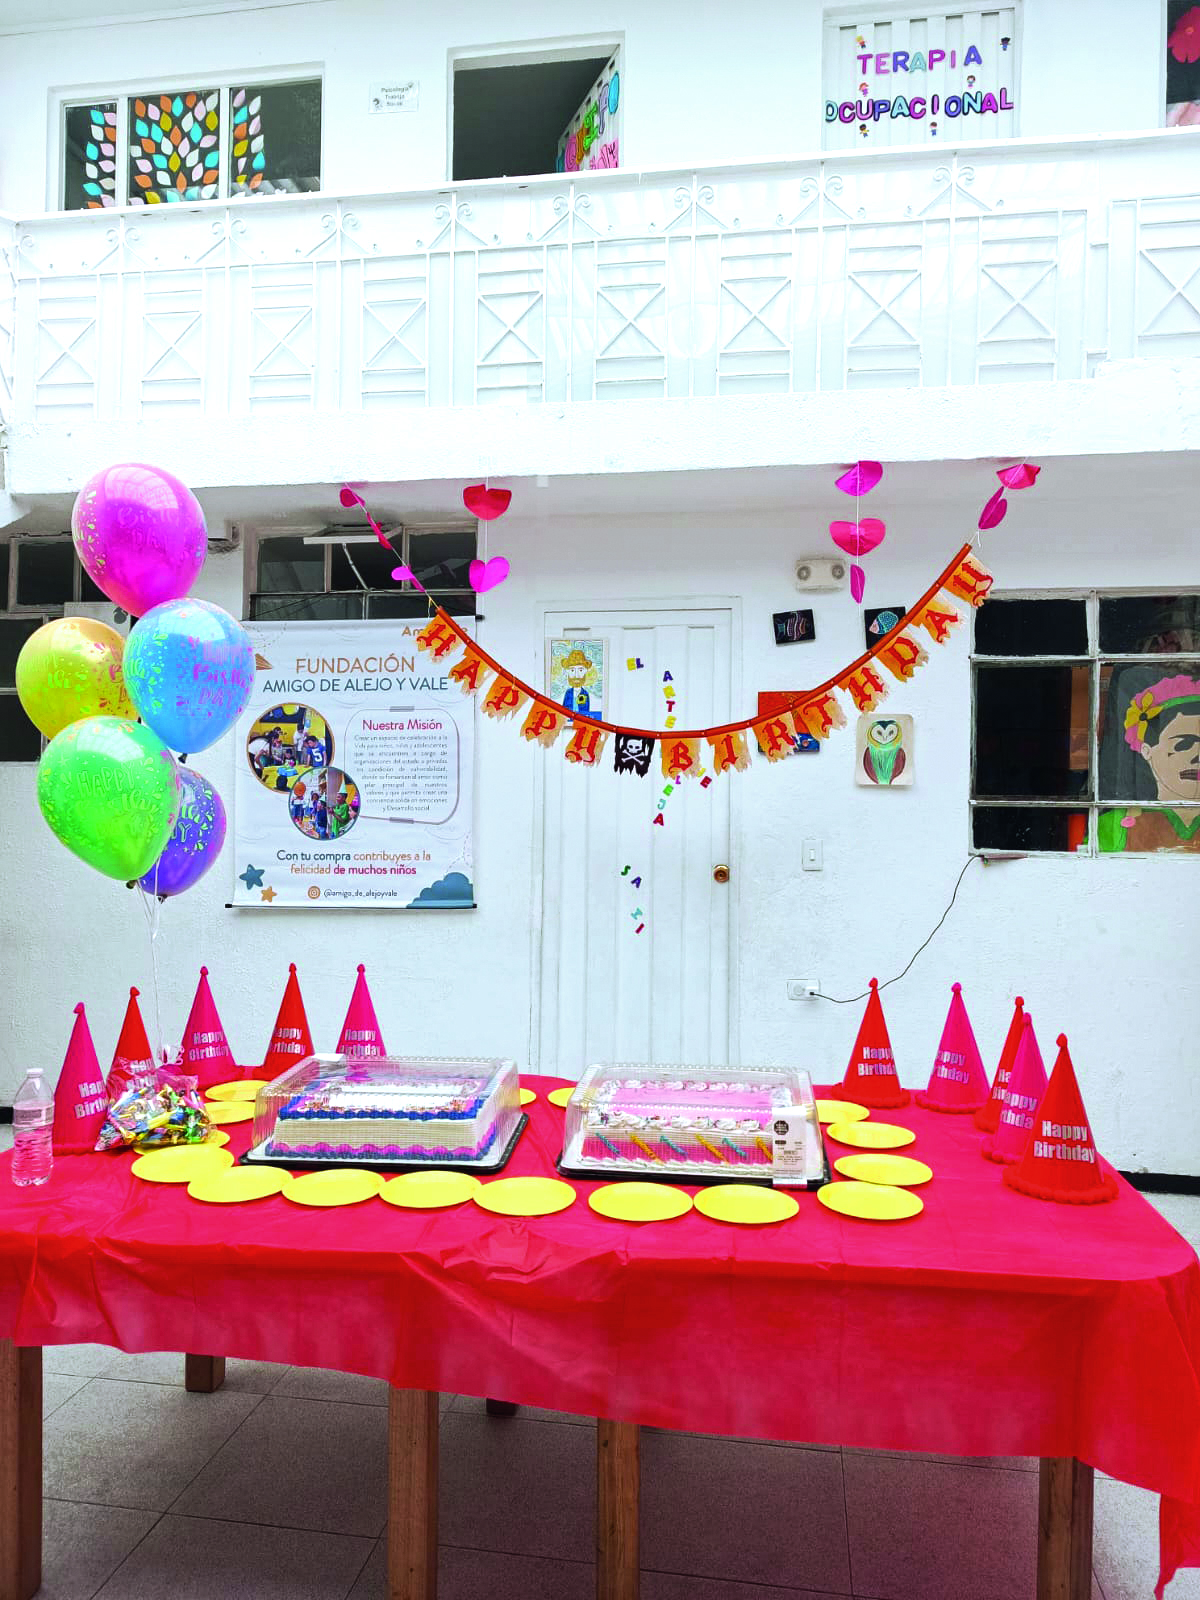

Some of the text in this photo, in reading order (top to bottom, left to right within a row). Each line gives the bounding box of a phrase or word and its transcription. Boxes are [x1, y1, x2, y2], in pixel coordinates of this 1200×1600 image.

[857, 45, 983, 75] TERAPIA
[825, 88, 1014, 123] OCUPACIONAL
[296, 653, 415, 674] FUNDACIÓN
[626, 657, 644, 671] EL
[668, 561, 994, 774] BIRTHDAY
[263, 677, 449, 693] AMIGO DE ALEJO Y VALE
[416, 624, 602, 764] HAPPY
[362, 718, 443, 731] Nuestra Misión
[312, 748, 323, 762] 5
[276, 850, 431, 864] Con tu compra contribuyes a la
[290, 863, 417, 875] felicidad de muchos niños
[194, 1031, 224, 1044] Happy
[278, 1028, 303, 1039] appy
[937, 1050, 965, 1066] appy
[1003, 1091, 1038, 1112] appy
[1042, 1120, 1087, 1142] Happy
[1033, 1140, 1095, 1164] Birthday
